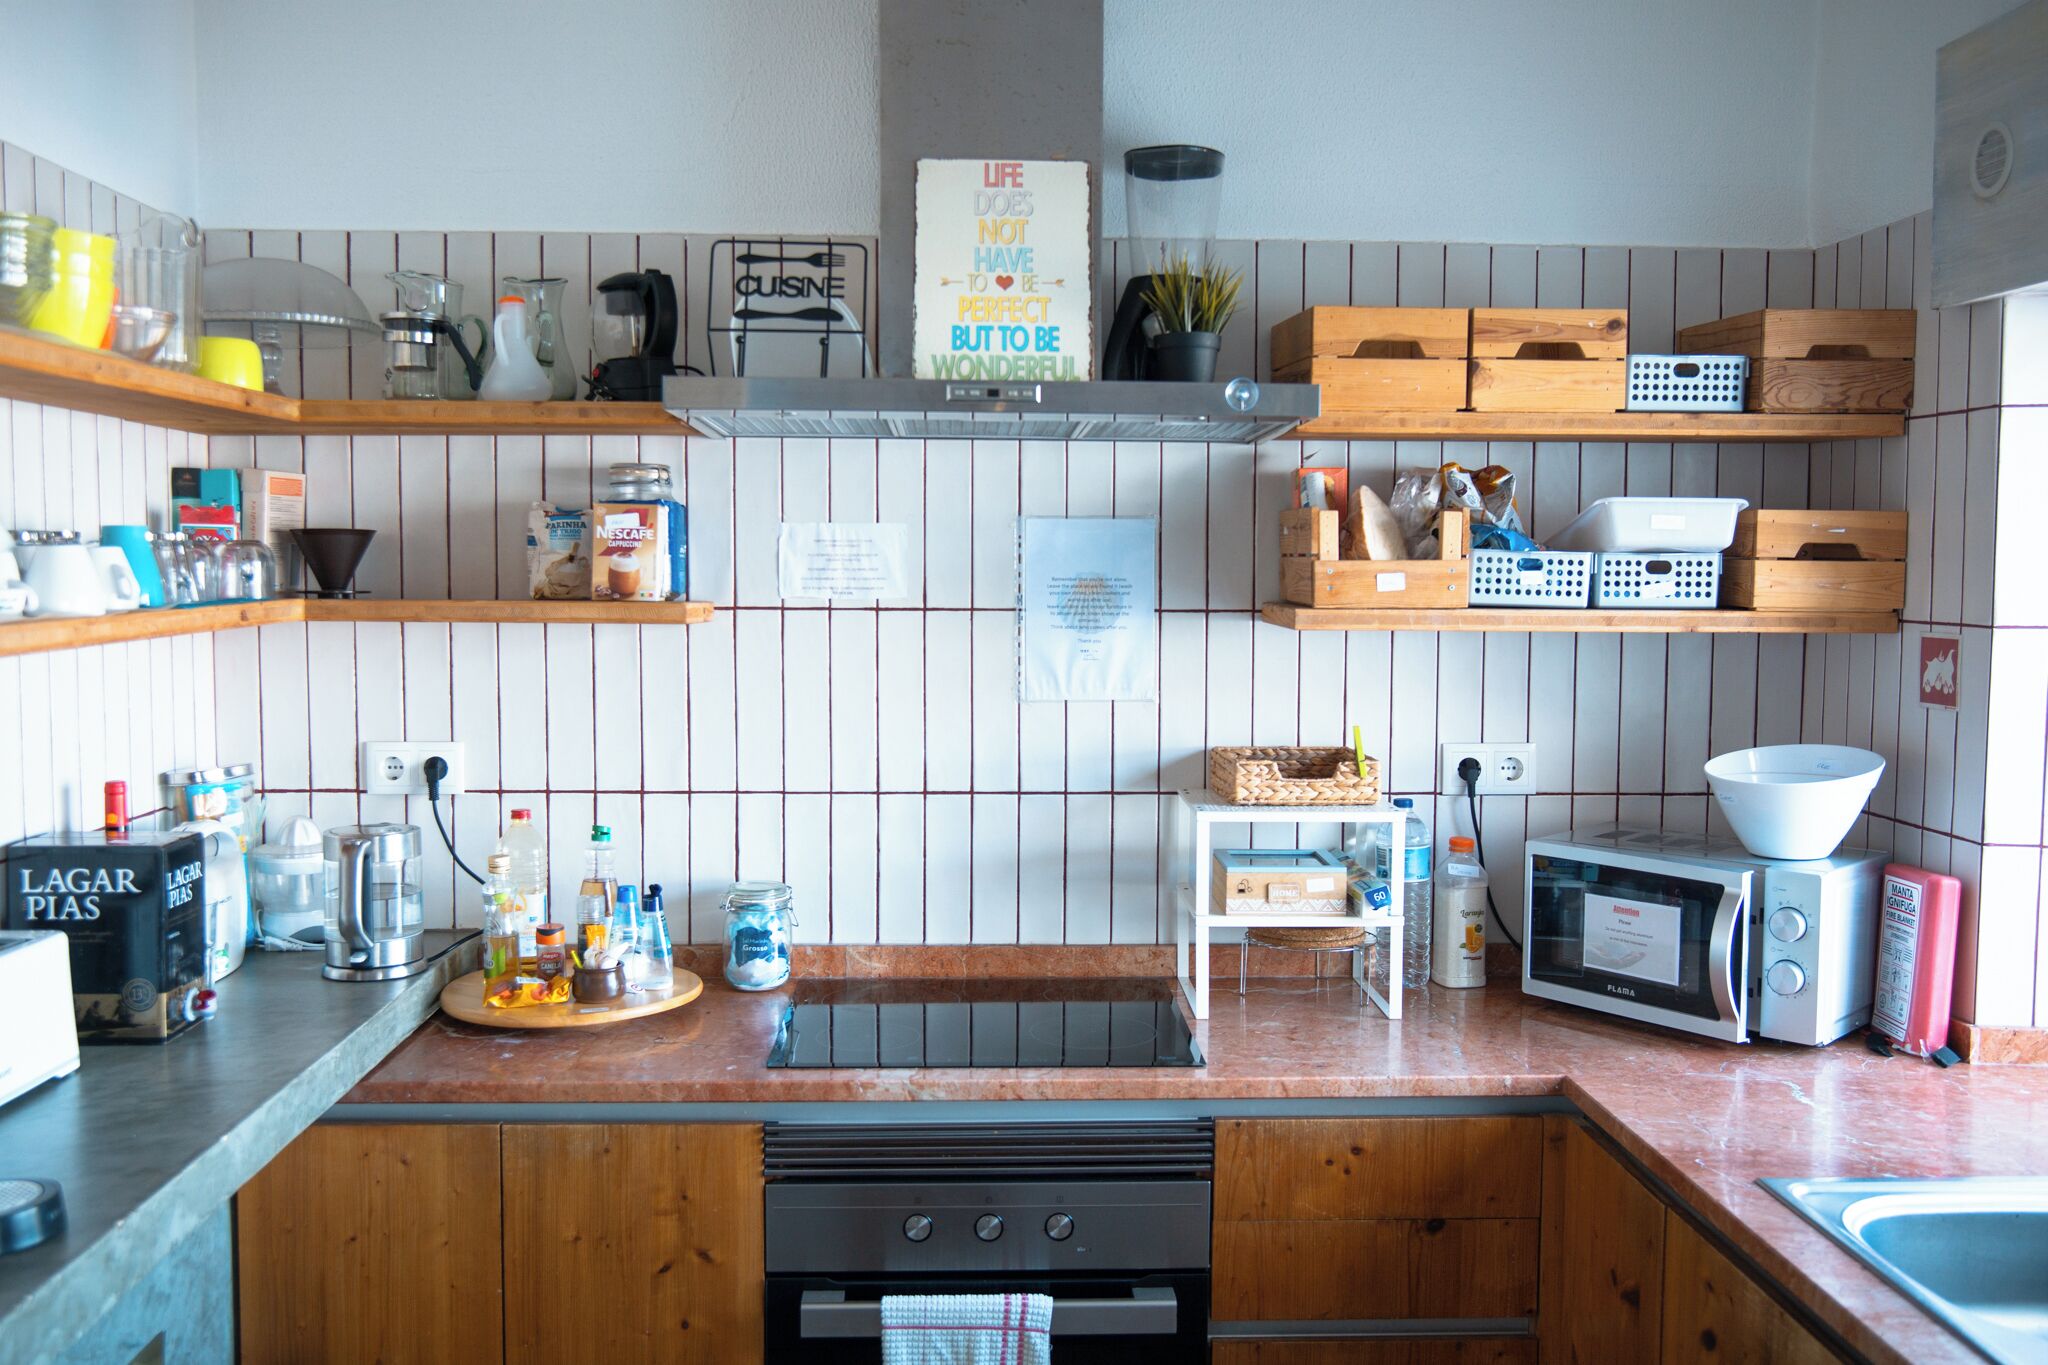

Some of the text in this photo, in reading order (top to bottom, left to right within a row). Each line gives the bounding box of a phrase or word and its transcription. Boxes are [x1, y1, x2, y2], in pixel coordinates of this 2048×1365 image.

[984, 162, 1024, 188] LIFE
[974, 190, 1034, 217] DOES
[977, 218, 1029, 245] NOT
[973, 246, 1034, 273] HAVE
[735, 275, 845, 298] CUISINE
[967, 273, 1039, 293] TO BE
[957, 295, 1052, 323] PERFECT
[951, 325, 1060, 352] BUT TO BE
[931, 353, 1081, 381] WONDERFUL
[21, 868, 142, 893] LAGAR
[167, 860, 203, 891] LAGAR
[168, 883, 193, 909] PIAS
[1271, 889, 1299, 898] HOME
[1373, 891, 1386, 901] 60
[1891, 884, 1914, 899] MANTA
[27, 895, 101, 920] PIAS
[1886, 910, 1915, 926] FIRE BLANKET
[742, 944, 768, 952] Grosso
[1607, 984, 1635, 996] FLAMA
